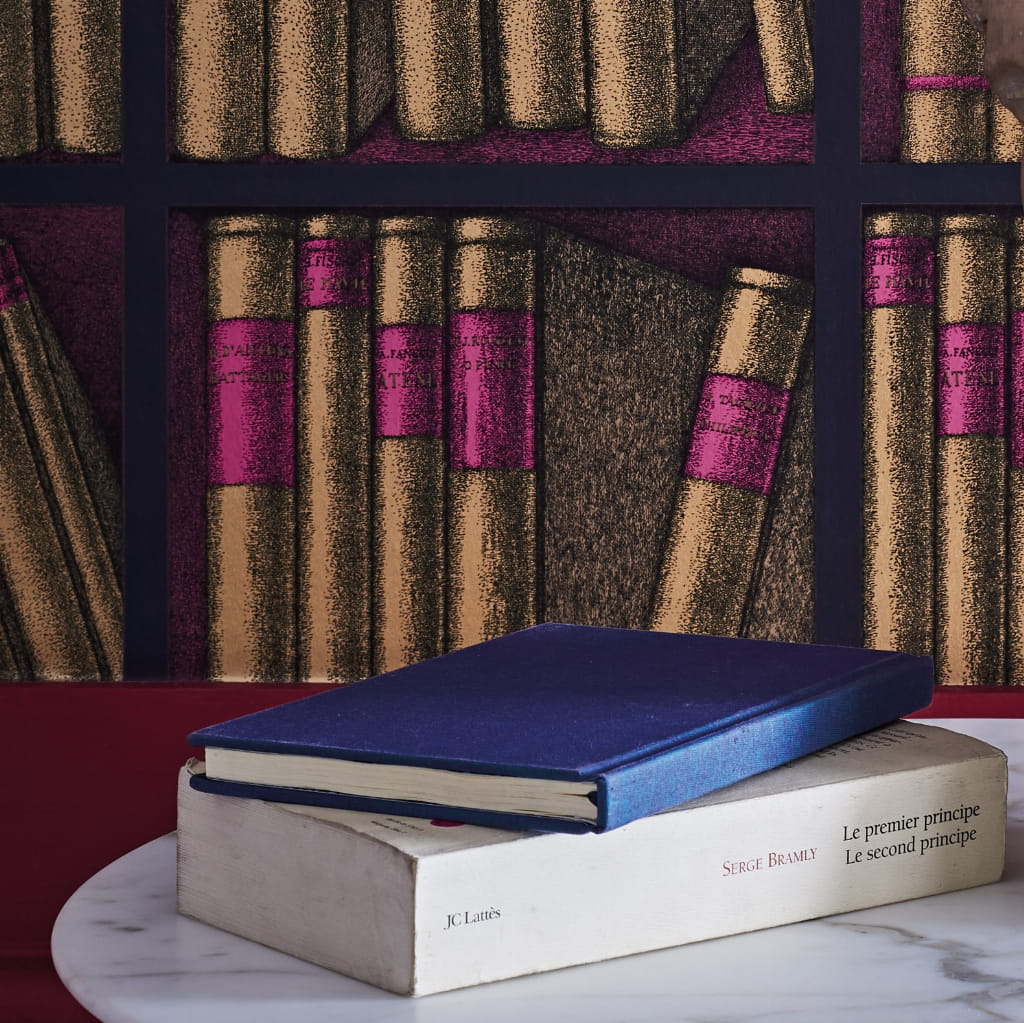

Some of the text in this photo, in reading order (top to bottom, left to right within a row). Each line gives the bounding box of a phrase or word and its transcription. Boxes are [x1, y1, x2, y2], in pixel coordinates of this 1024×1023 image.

[843, 804, 981, 843] Le premier principe
[722, 847, 818, 877] SERGE BRAMLY
[846, 828, 977, 865] Le second principe
[443, 906, 501, 931] JC Lattès
